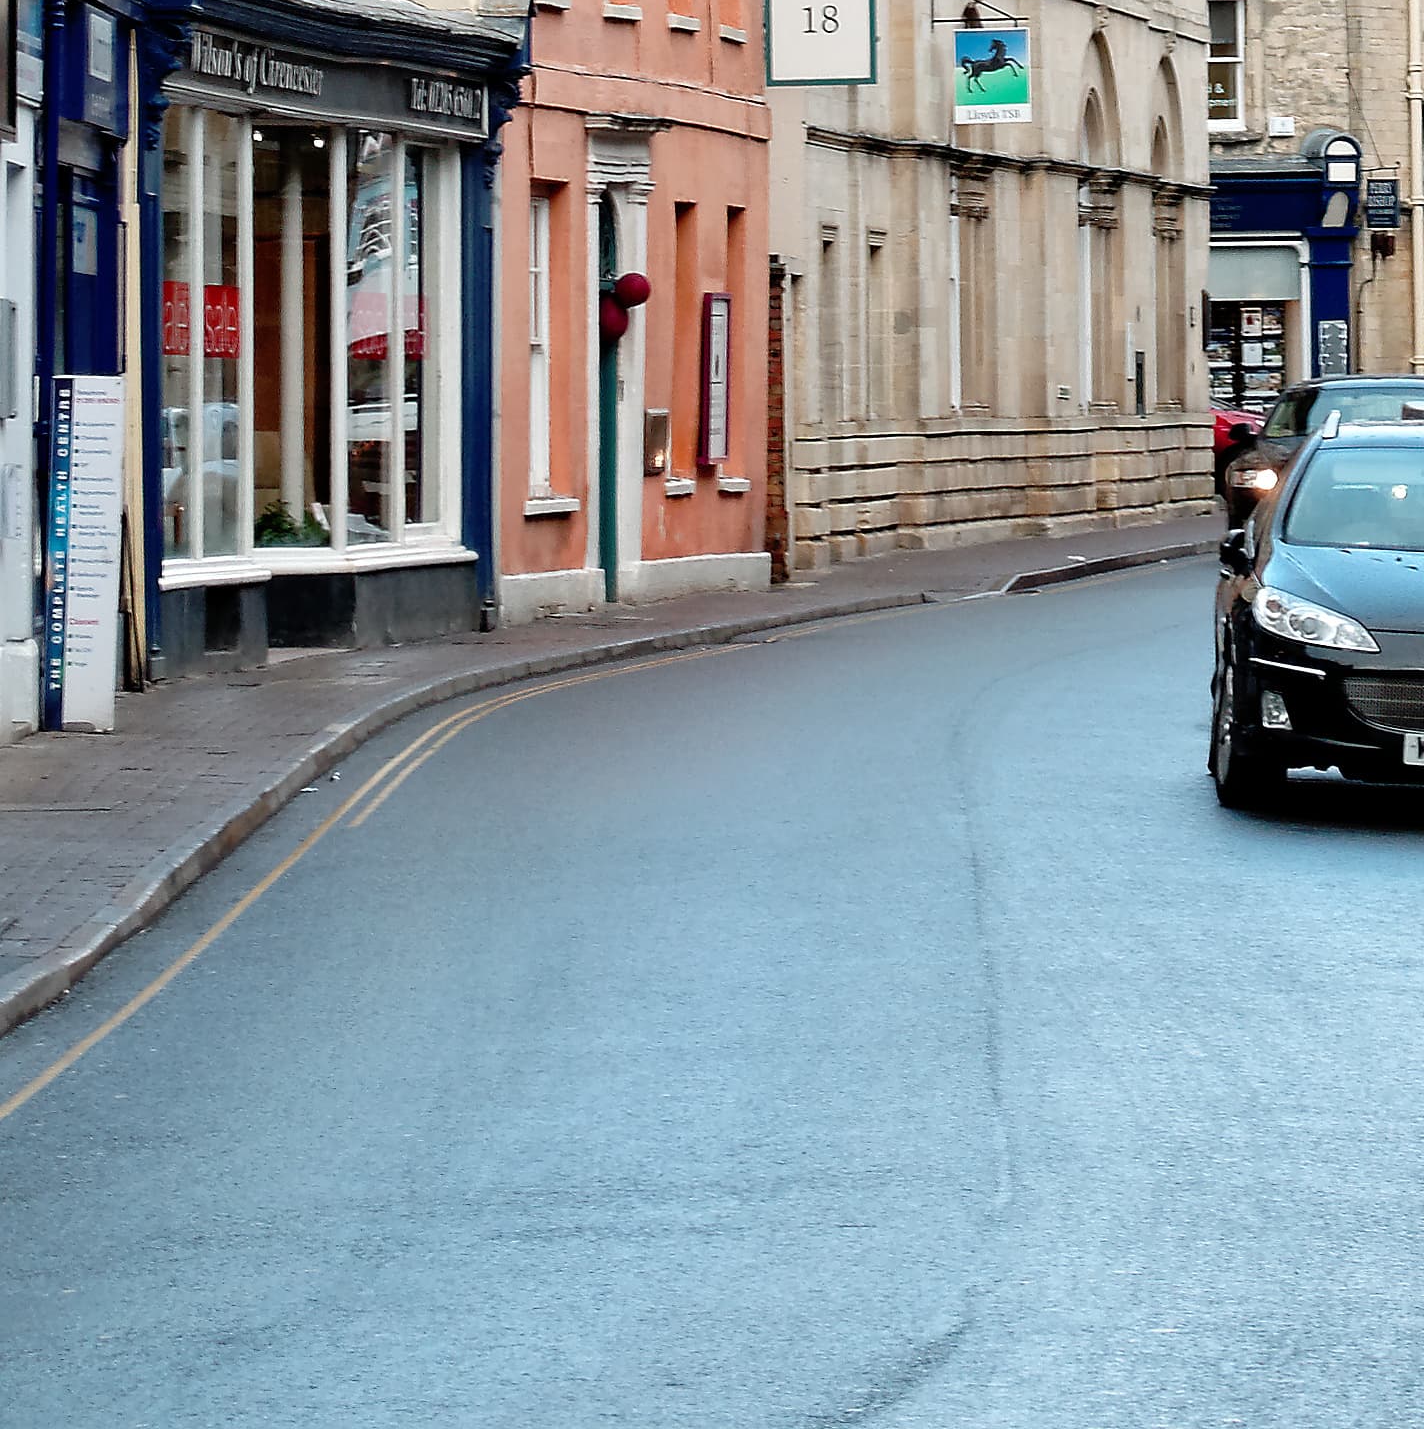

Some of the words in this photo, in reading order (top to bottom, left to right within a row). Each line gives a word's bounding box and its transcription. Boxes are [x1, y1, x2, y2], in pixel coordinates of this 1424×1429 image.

[802, 5, 839, 33] 18
[1002, 108, 1021, 119] TSB
[56, 389, 71, 458] CENTRE
[55, 470, 68, 538] HEALTH
[51, 550, 65, 644] COMPLETE
[50, 658, 62, 690] THE
